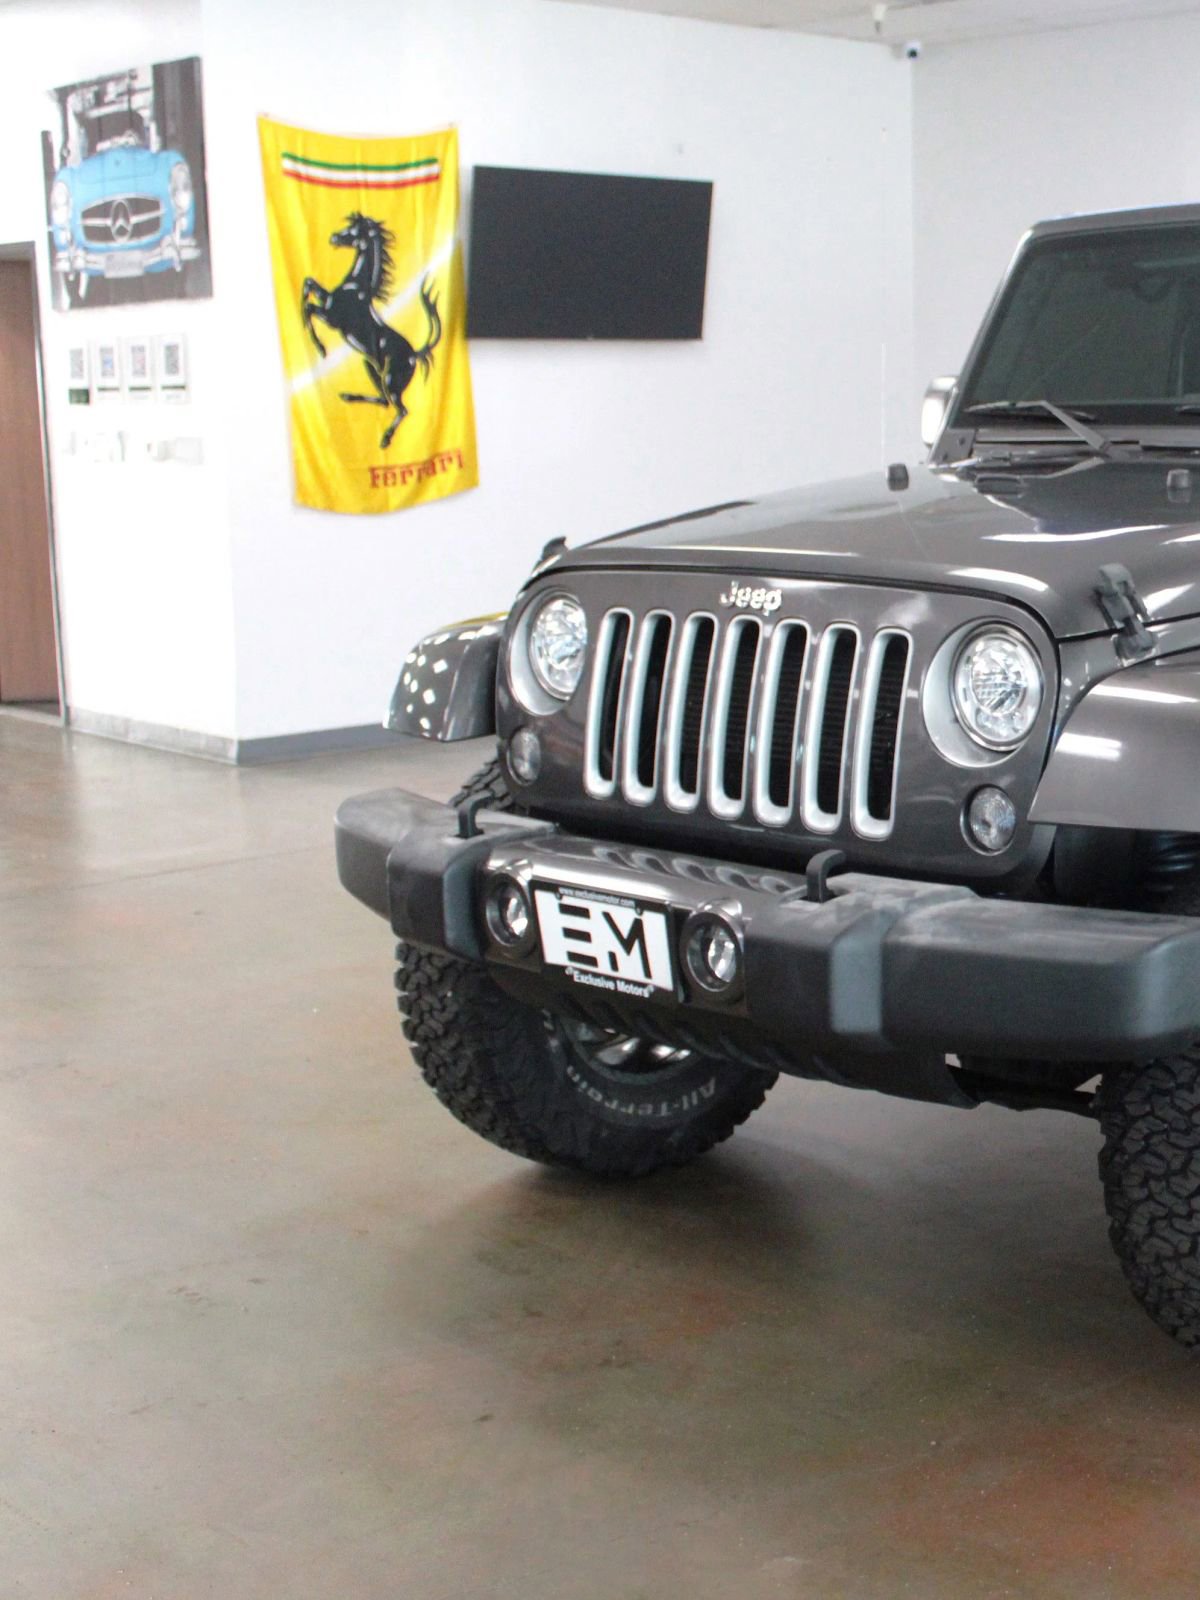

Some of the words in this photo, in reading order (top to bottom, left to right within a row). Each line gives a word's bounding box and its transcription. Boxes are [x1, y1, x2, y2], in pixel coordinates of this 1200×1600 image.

[368, 448, 464, 489] Ferrari
[719, 580, 782, 617] Jeep
[558, 903, 652, 980] EM
[573, 969, 616, 991] Exclusive
[616, 980, 650, 998] Motors
